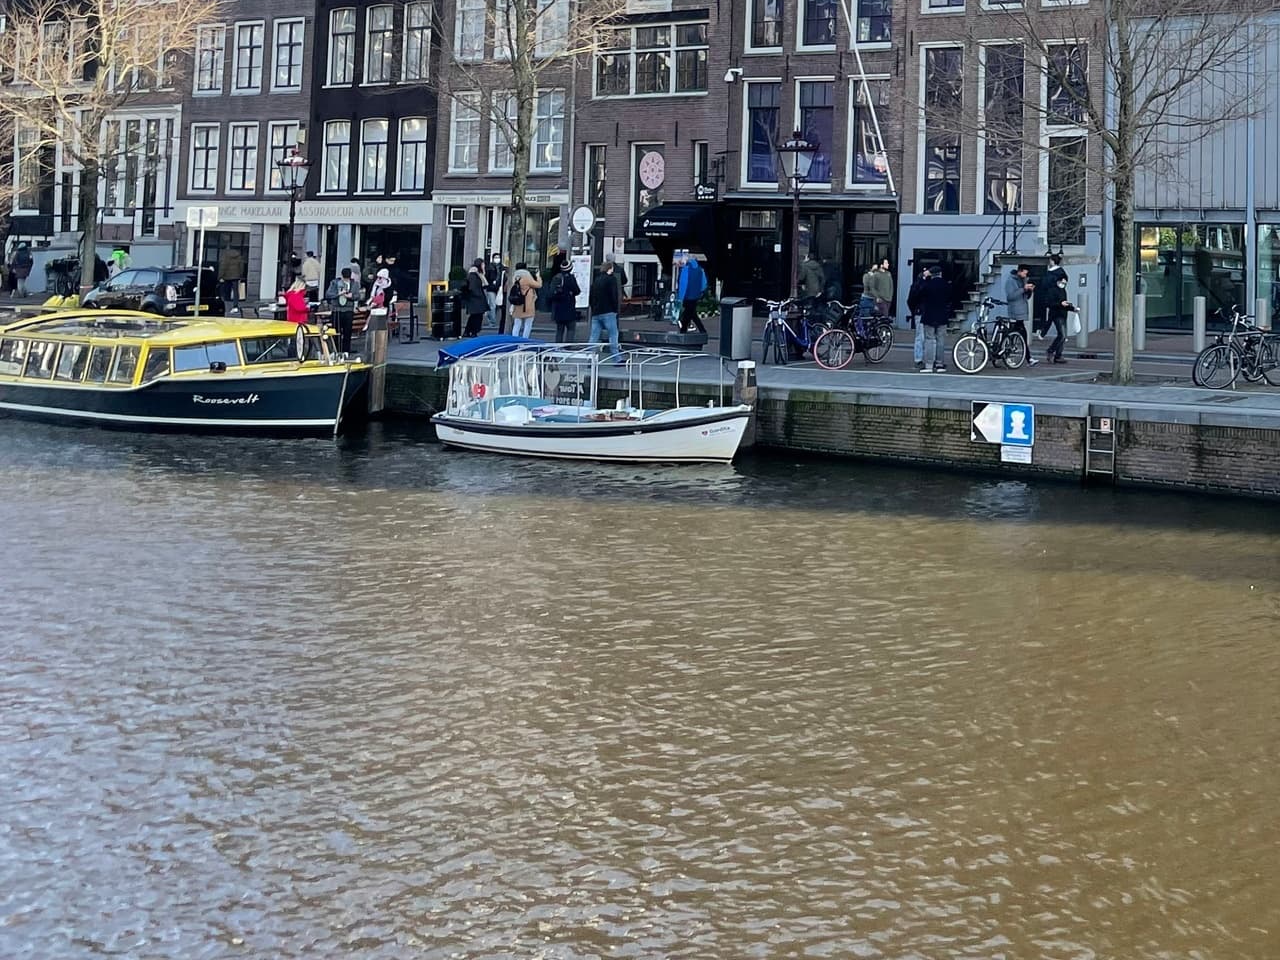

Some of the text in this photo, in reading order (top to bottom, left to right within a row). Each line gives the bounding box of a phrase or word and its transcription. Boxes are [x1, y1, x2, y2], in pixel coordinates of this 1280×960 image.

[240, 206, 282, 217] MAKELAAR
[298, 206, 354, 217] ASSURADEUR
[357, 206, 409, 217] AANNEMER
[192, 393, 260, 404] Roosevelt
